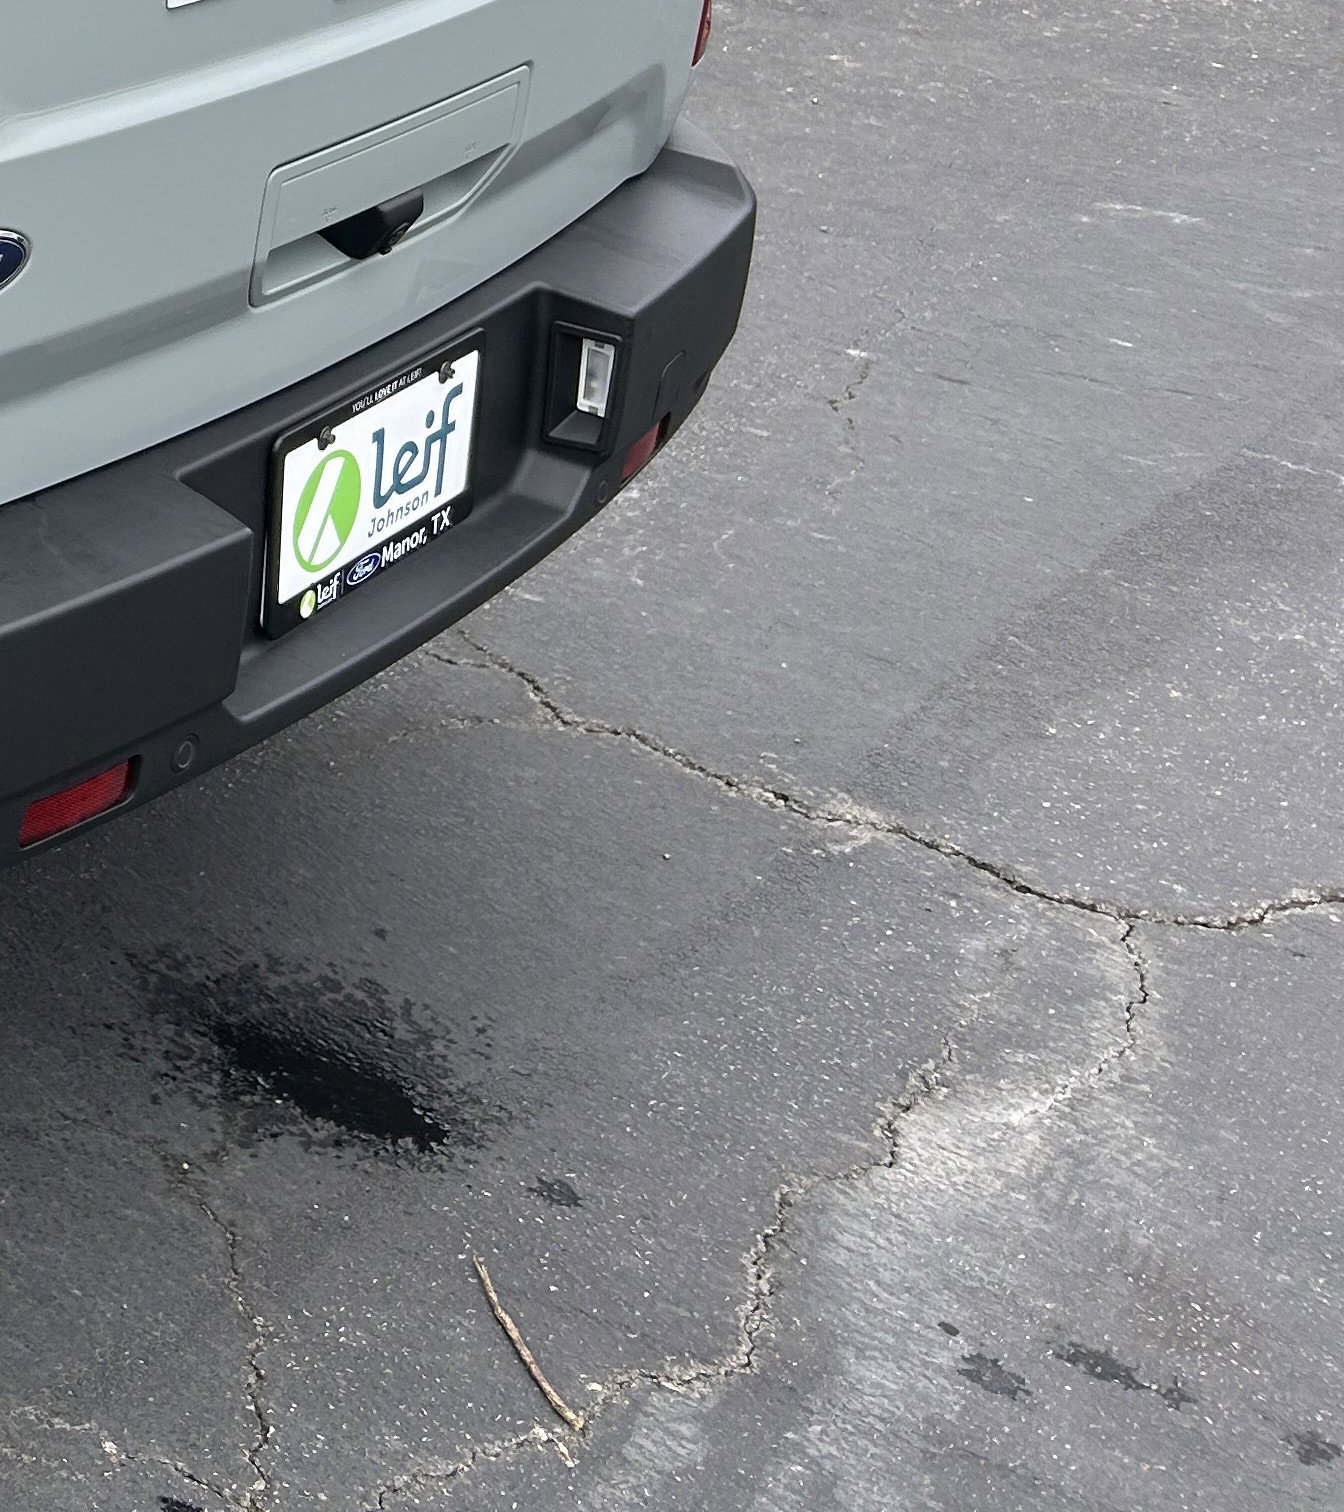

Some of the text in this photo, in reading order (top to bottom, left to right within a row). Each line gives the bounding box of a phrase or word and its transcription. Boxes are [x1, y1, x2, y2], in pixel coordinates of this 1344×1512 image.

[375, 384, 392, 400] LOVE
[392, 380, 399, 392] IT
[398, 375, 407, 387] AT
[372, 382, 464, 509] leif
[367, 490, 430, 538] Johnson
[381, 527, 428, 568] Manor,
[431, 506, 452, 535] TX
